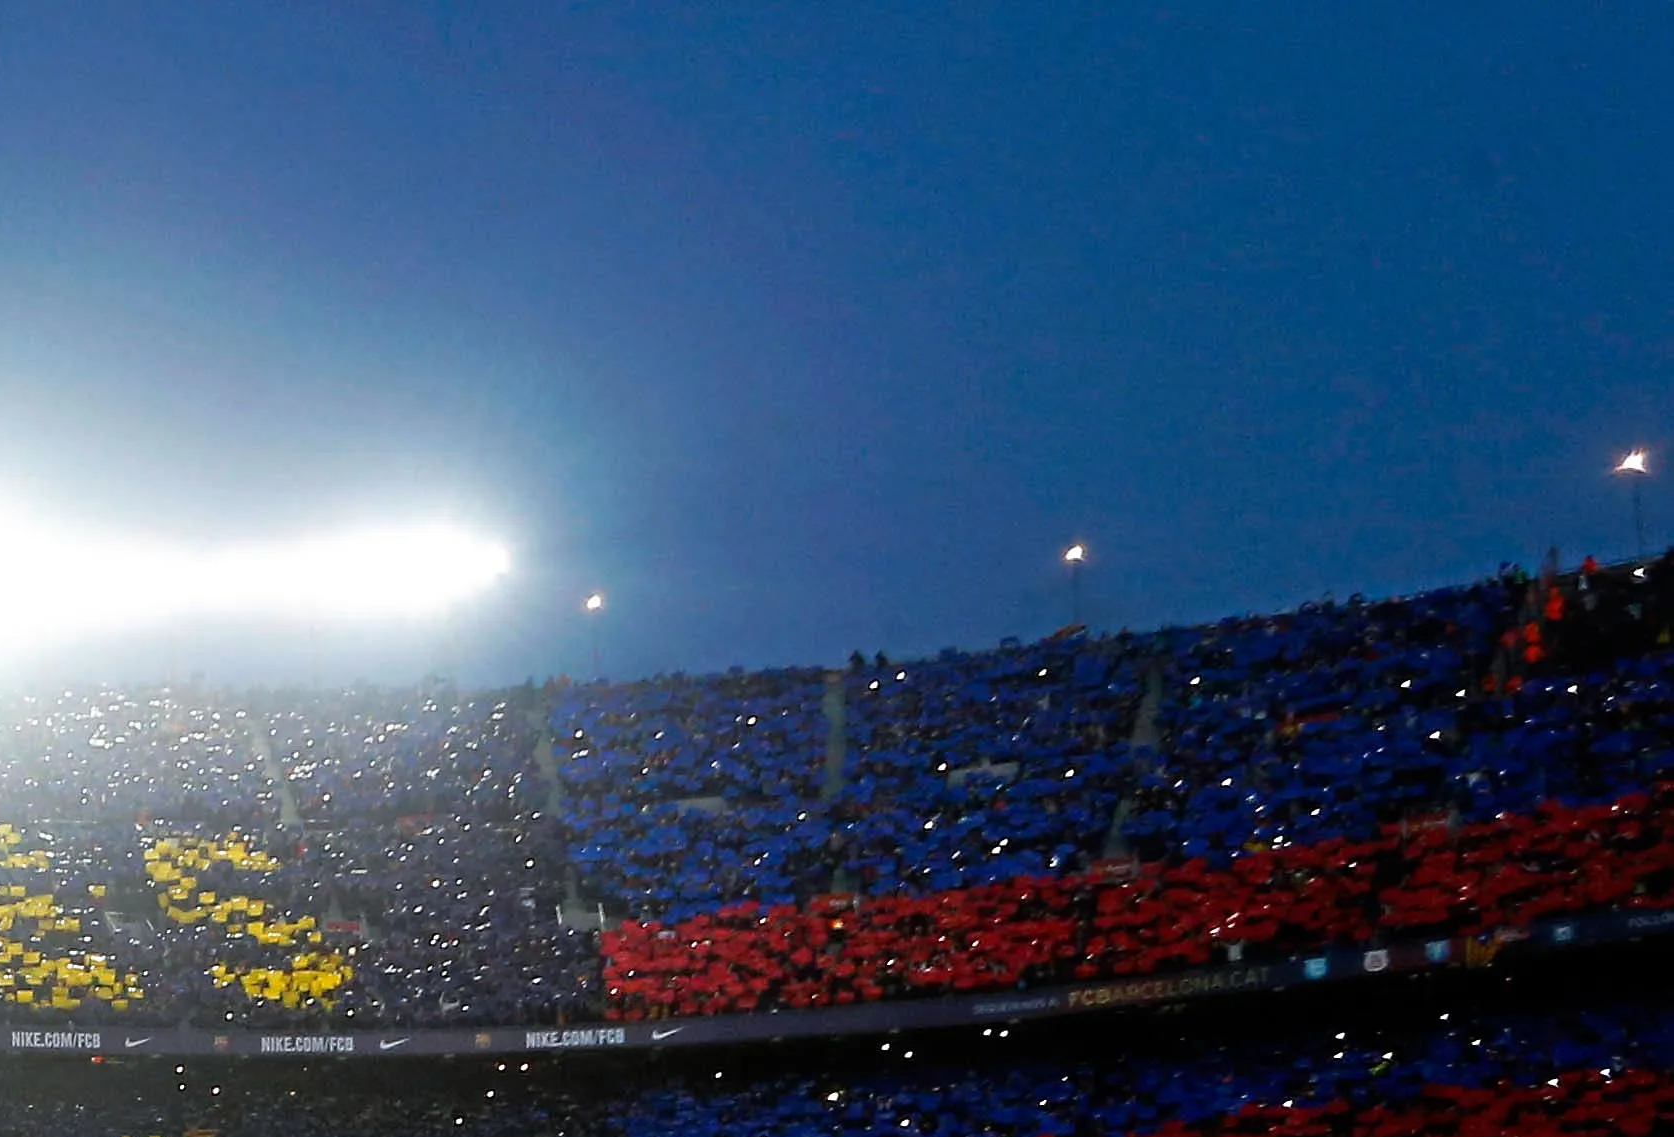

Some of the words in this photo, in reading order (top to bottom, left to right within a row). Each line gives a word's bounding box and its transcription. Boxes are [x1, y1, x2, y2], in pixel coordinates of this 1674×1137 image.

[11, 1029, 102, 1050] NIKE.COM/FCB
[260, 1035, 354, 1054] NIKE.COM/FCB
[526, 1027, 627, 1050] NIKE.COM/FCB
